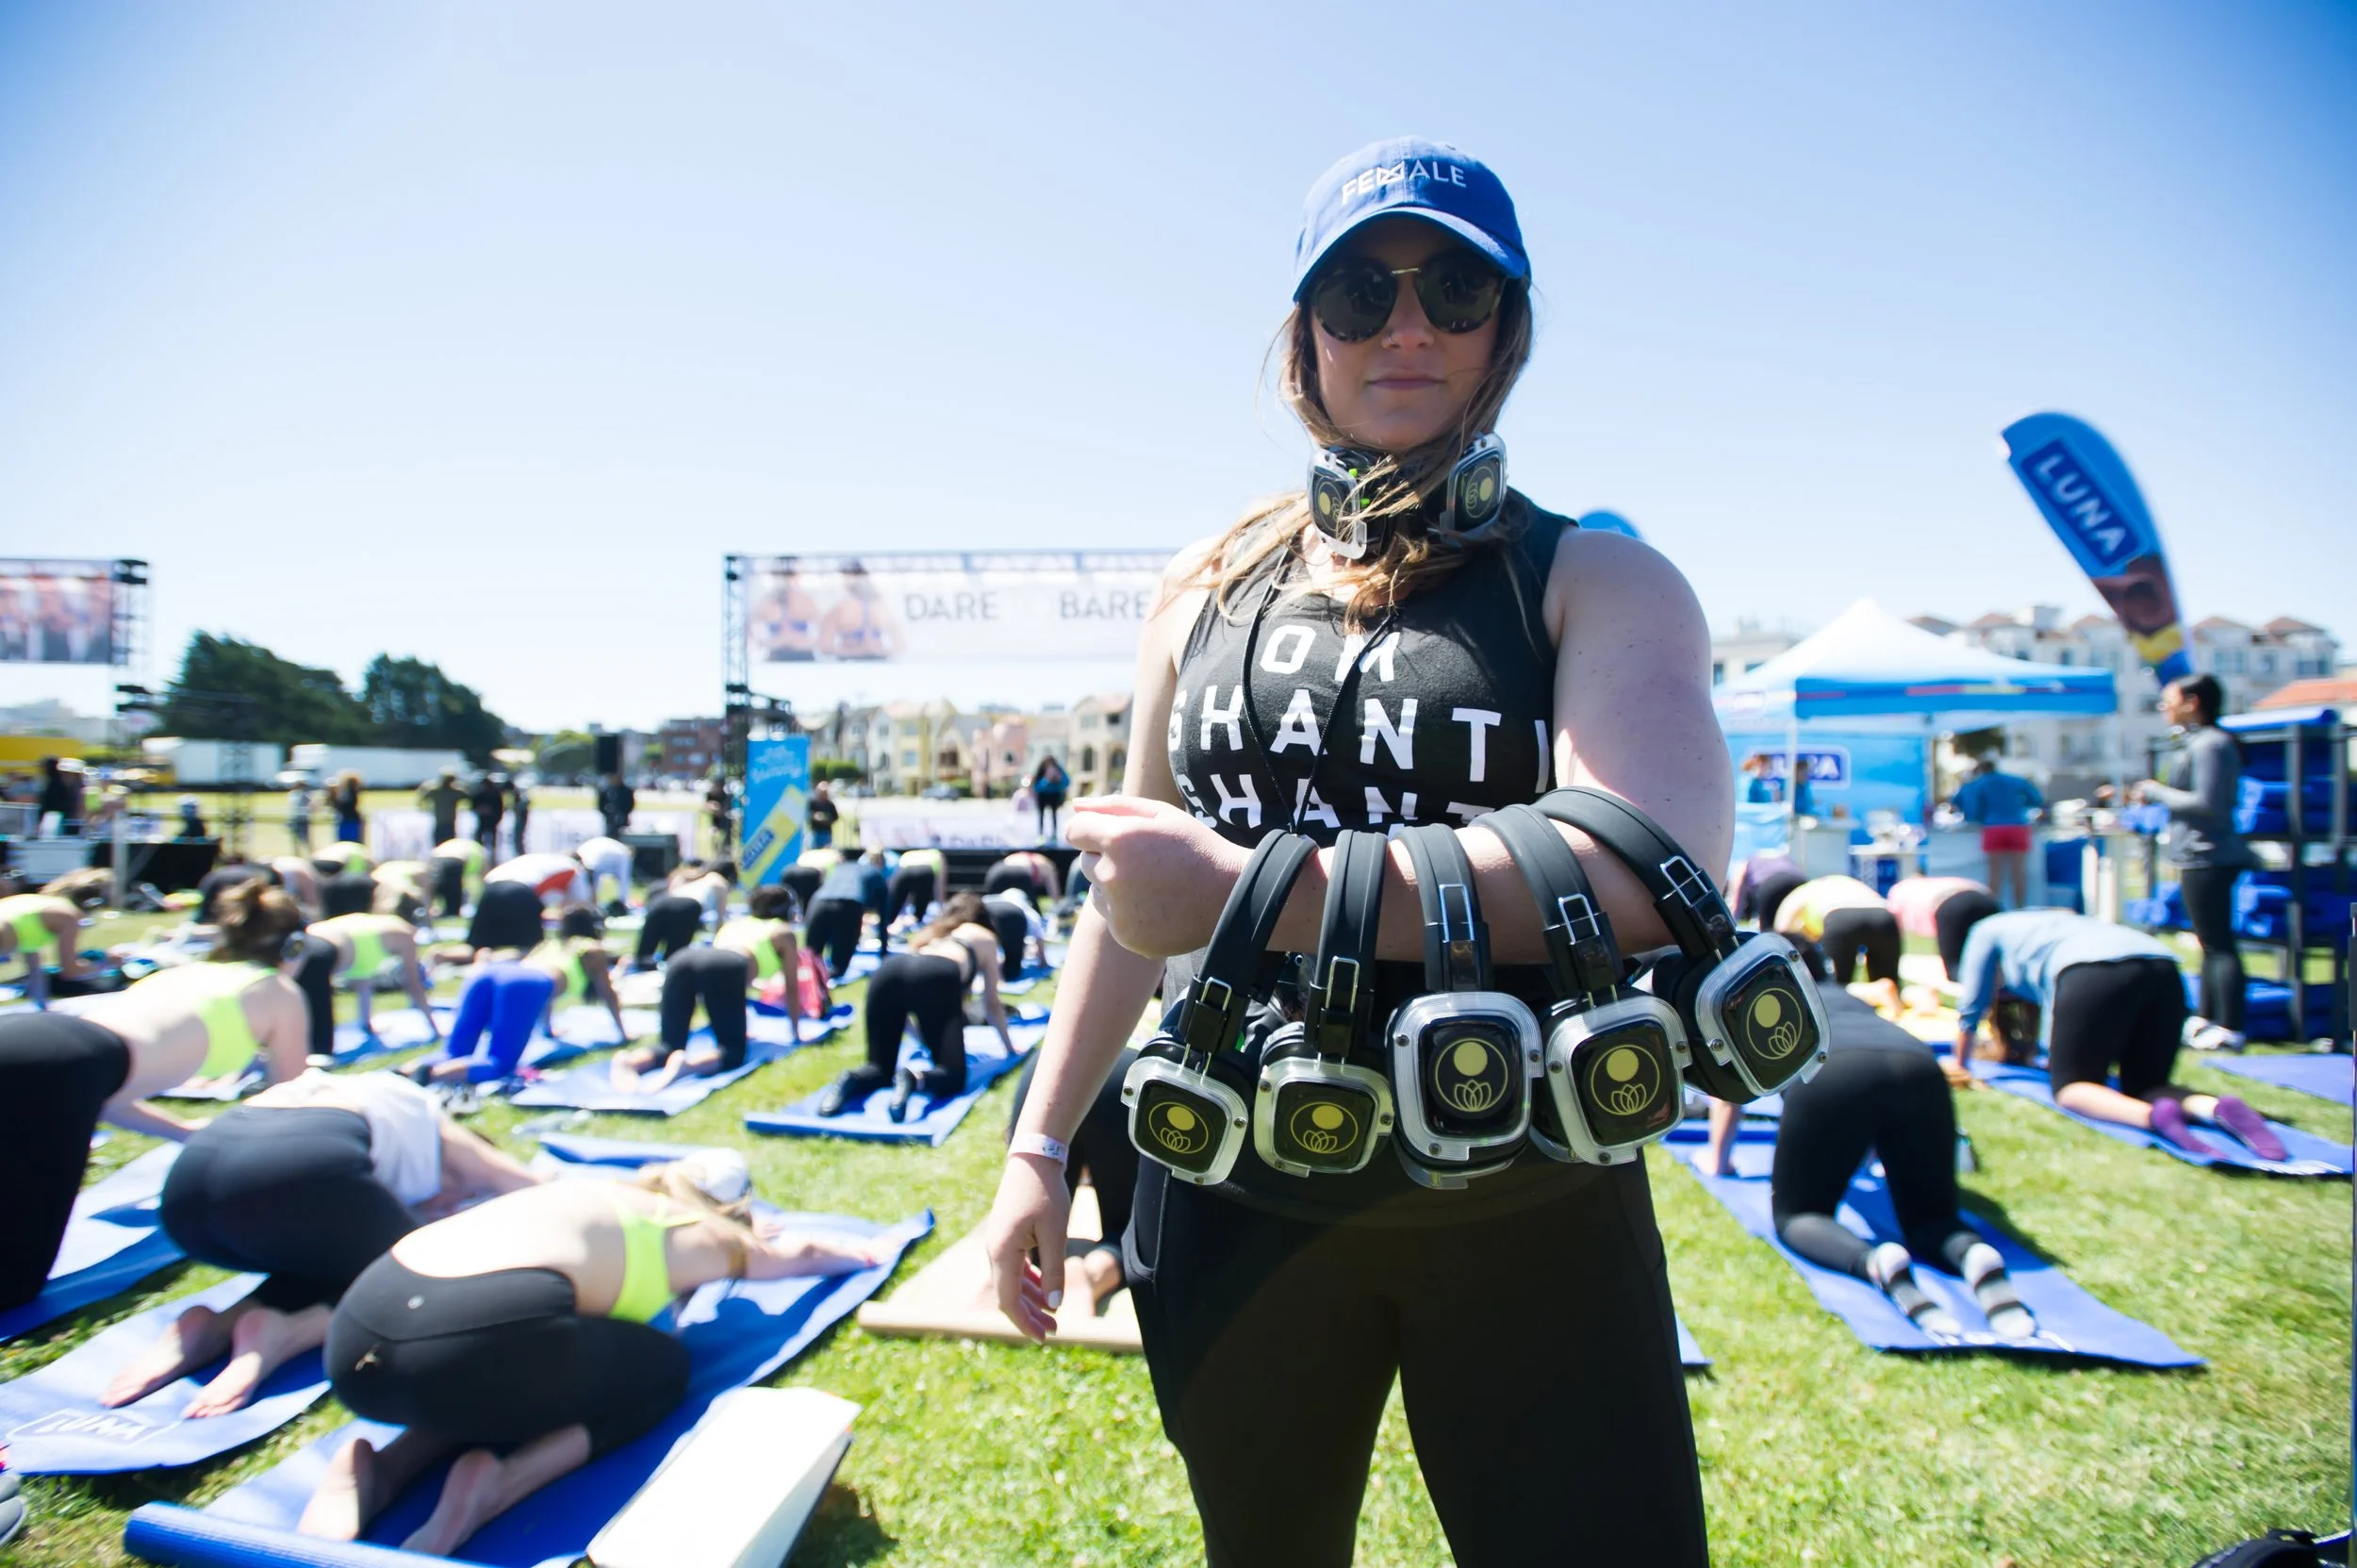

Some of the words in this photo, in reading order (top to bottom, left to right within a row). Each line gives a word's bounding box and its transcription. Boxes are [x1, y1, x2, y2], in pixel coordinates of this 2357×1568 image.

[1341, 158, 1467, 206] FEMALE
[2036, 453, 2127, 556] LUNA
[903, 591, 999, 621] DARE
[1059, 589, 1151, 620] BARE
[1260, 624, 1400, 683] OM
[1168, 684, 1550, 794] SHANTI
